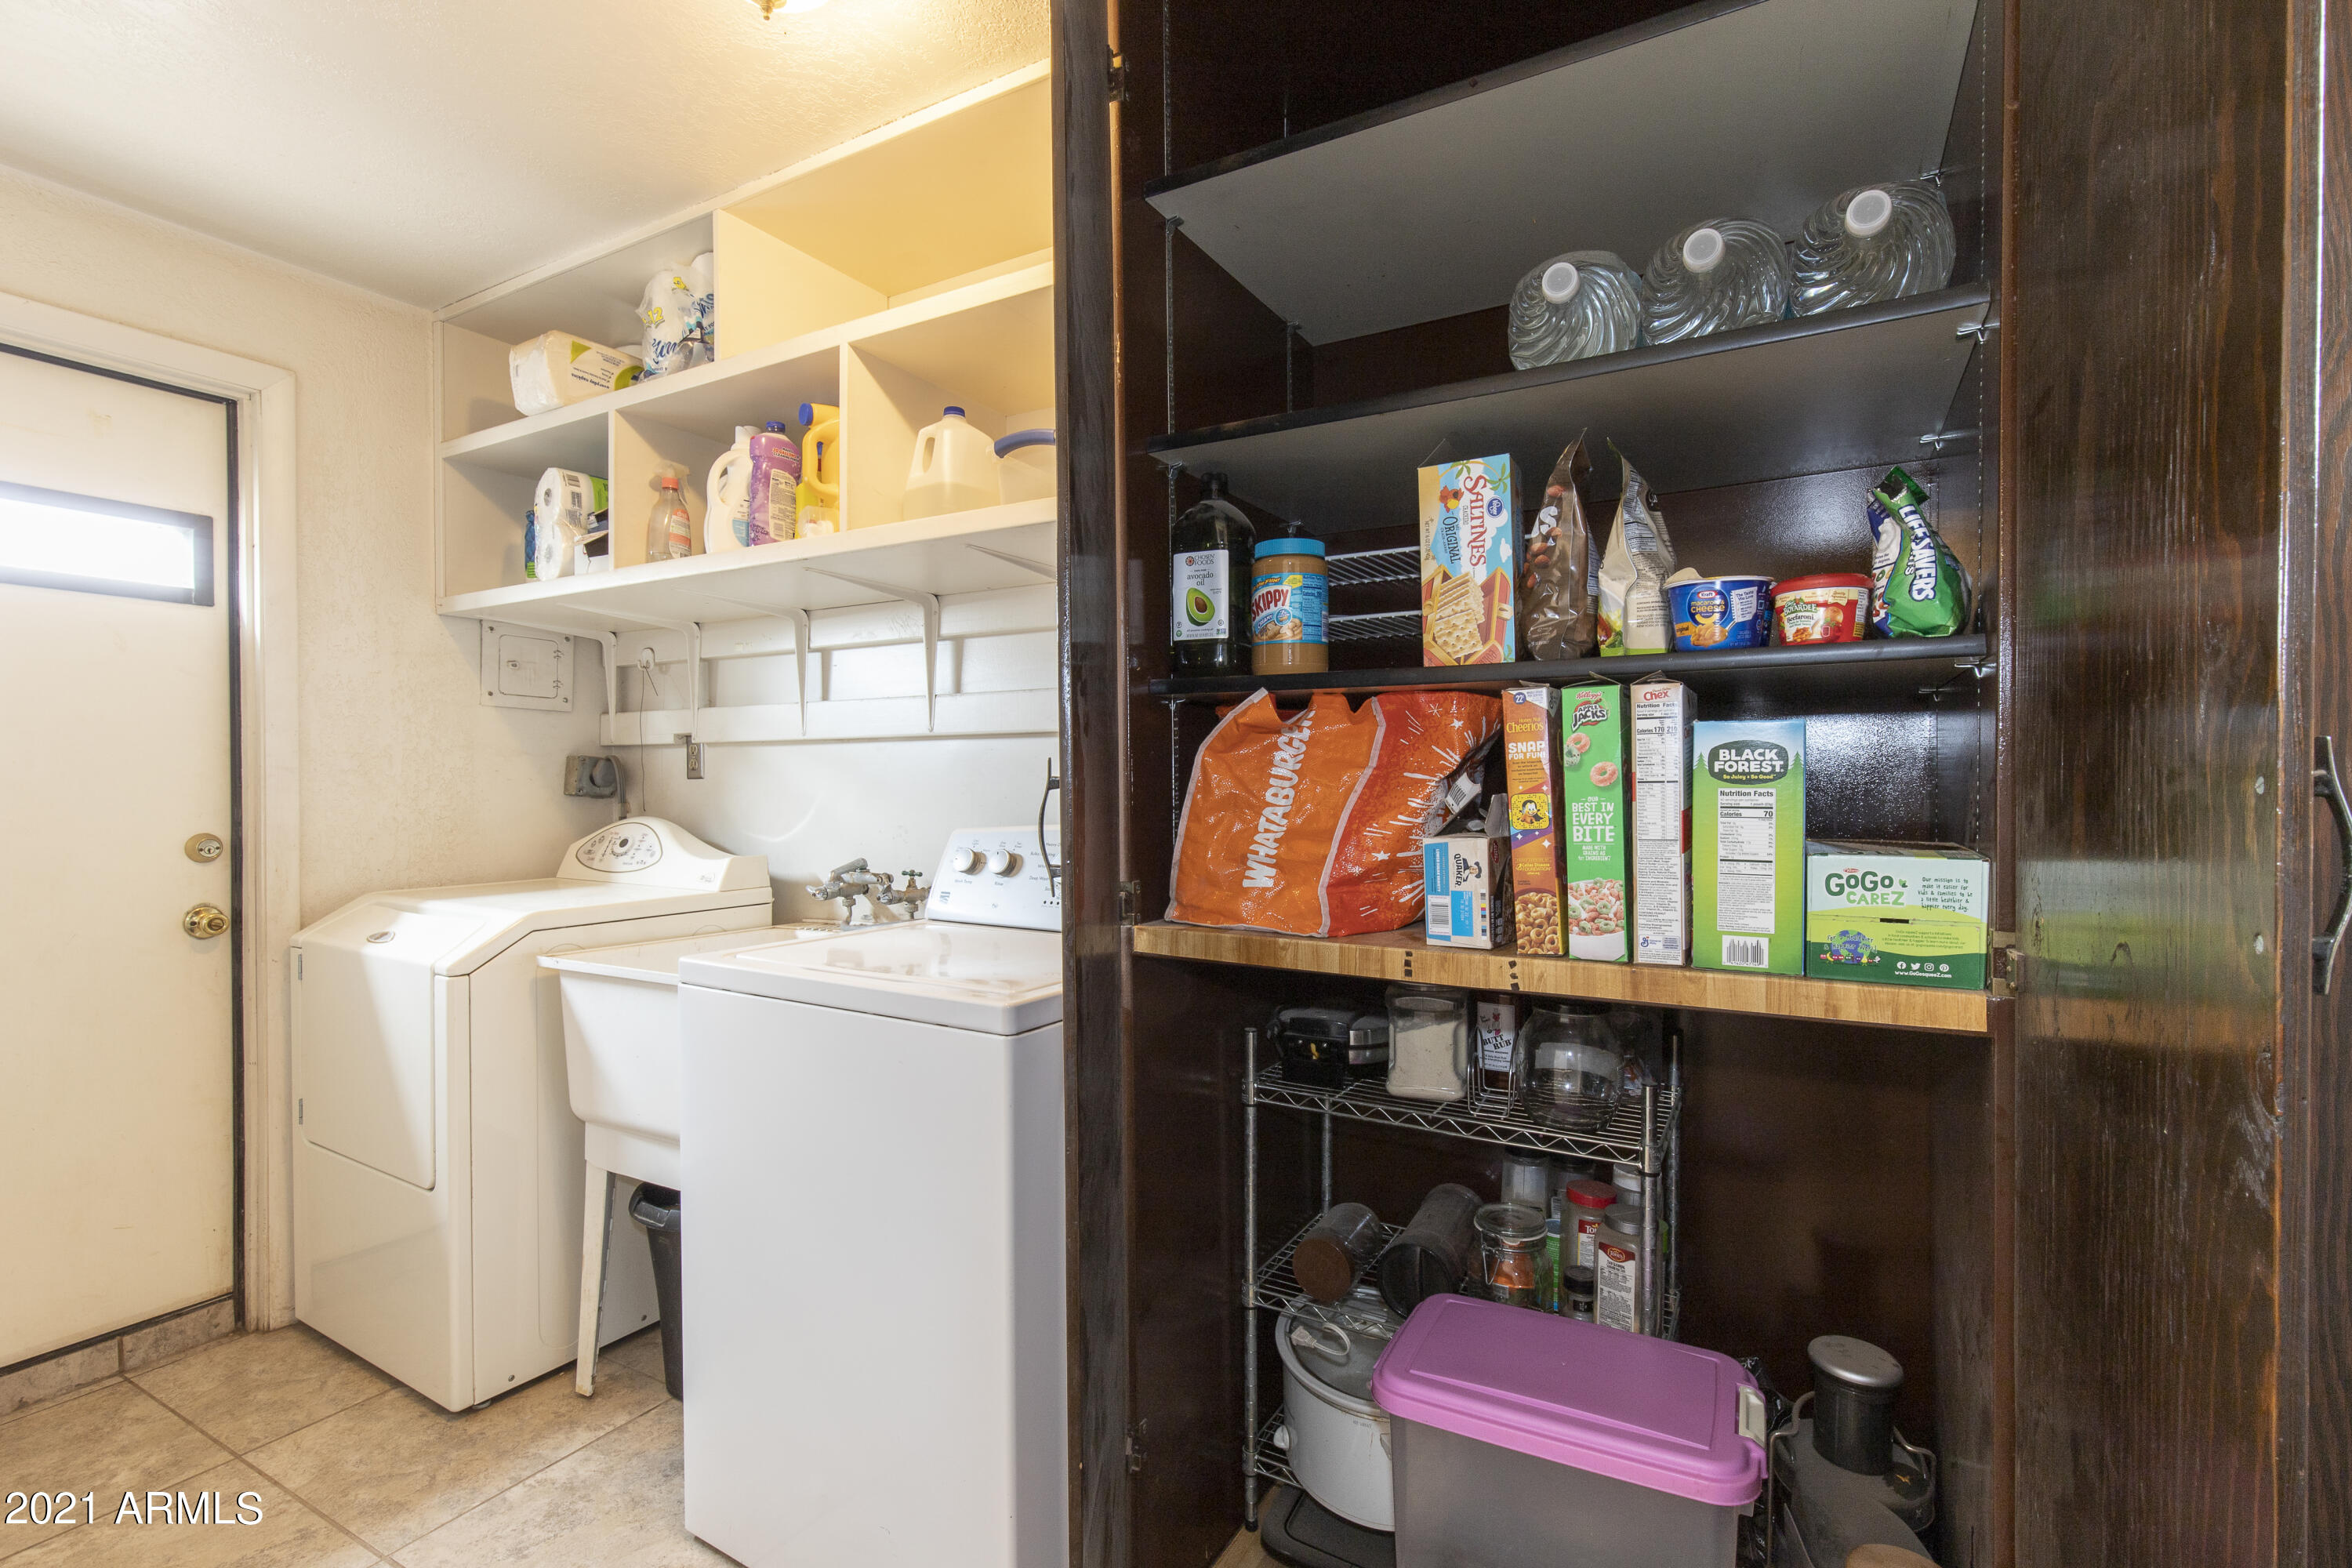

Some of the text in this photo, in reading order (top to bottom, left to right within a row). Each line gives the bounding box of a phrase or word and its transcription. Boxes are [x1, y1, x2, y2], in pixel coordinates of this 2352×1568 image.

[1463, 474, 1488, 567] SALTINES
[1443, 516, 1461, 564] ORIGINAL
[1911, 537, 1936, 601] SAVERS
[1187, 572, 1214, 580] avocado
[1251, 588, 1289, 622] SKIPPY
[1783, 604, 1817, 615] BOYARDEE
[1787, 614, 1814, 623] Beefaroni
[1576, 690, 1602, 700] Kellogg's
[1644, 691, 1669, 701] Chex
[1573, 709, 1606, 728] JACKS
[1506, 722, 1544, 733] Cheerios
[1508, 741, 1546, 753] SNAP
[1719, 749, 1779, 761] BLACK
[1572, 802, 1614, 812] BEST IN
[1572, 812, 1613, 825] EVERY
[1573, 826, 1615, 842] BITE
[1454, 853, 1463, 886] QUAKER
[1825, 871, 1894, 896] GoGo
[1846, 891, 1904, 906] CAREZ
[1922, 902, 1939, 911] happier
[1958, 903, 1969, 912] day.
[1846, 934, 1874, 943] Healthier
[1832, 943, 1856, 951] Happier
[1859, 943, 1878, 954] World
[1483, 1034, 1512, 1050] BUTT RUB
